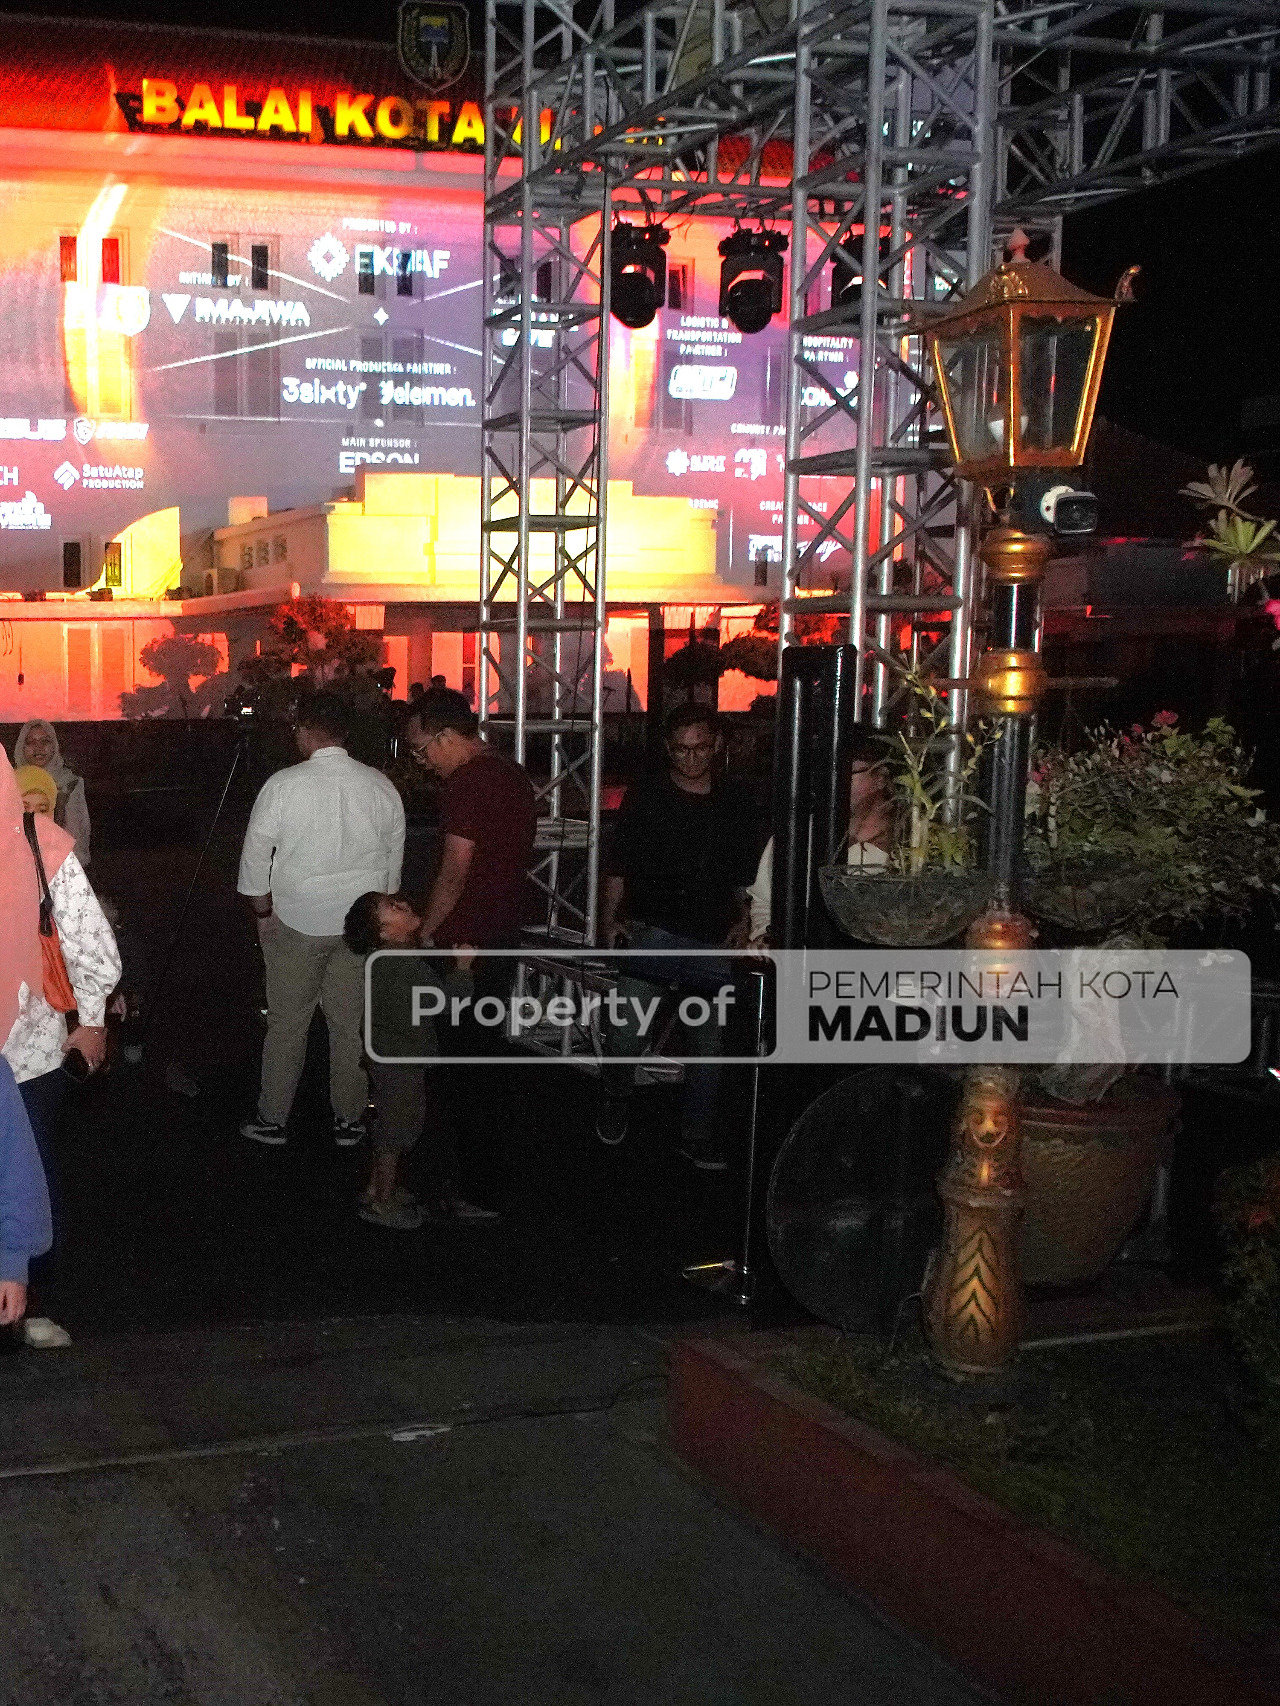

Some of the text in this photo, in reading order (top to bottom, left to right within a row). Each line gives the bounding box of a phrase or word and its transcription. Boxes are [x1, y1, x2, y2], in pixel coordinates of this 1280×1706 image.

[141, 78, 313, 134] BALAI
[335, 92, 485, 145] KOTA
[305, 357, 347, 371] OFFICIAL
[341, 437, 411, 448] MAIN SPONSOR
[82, 479, 144, 489] PRODUCTION
